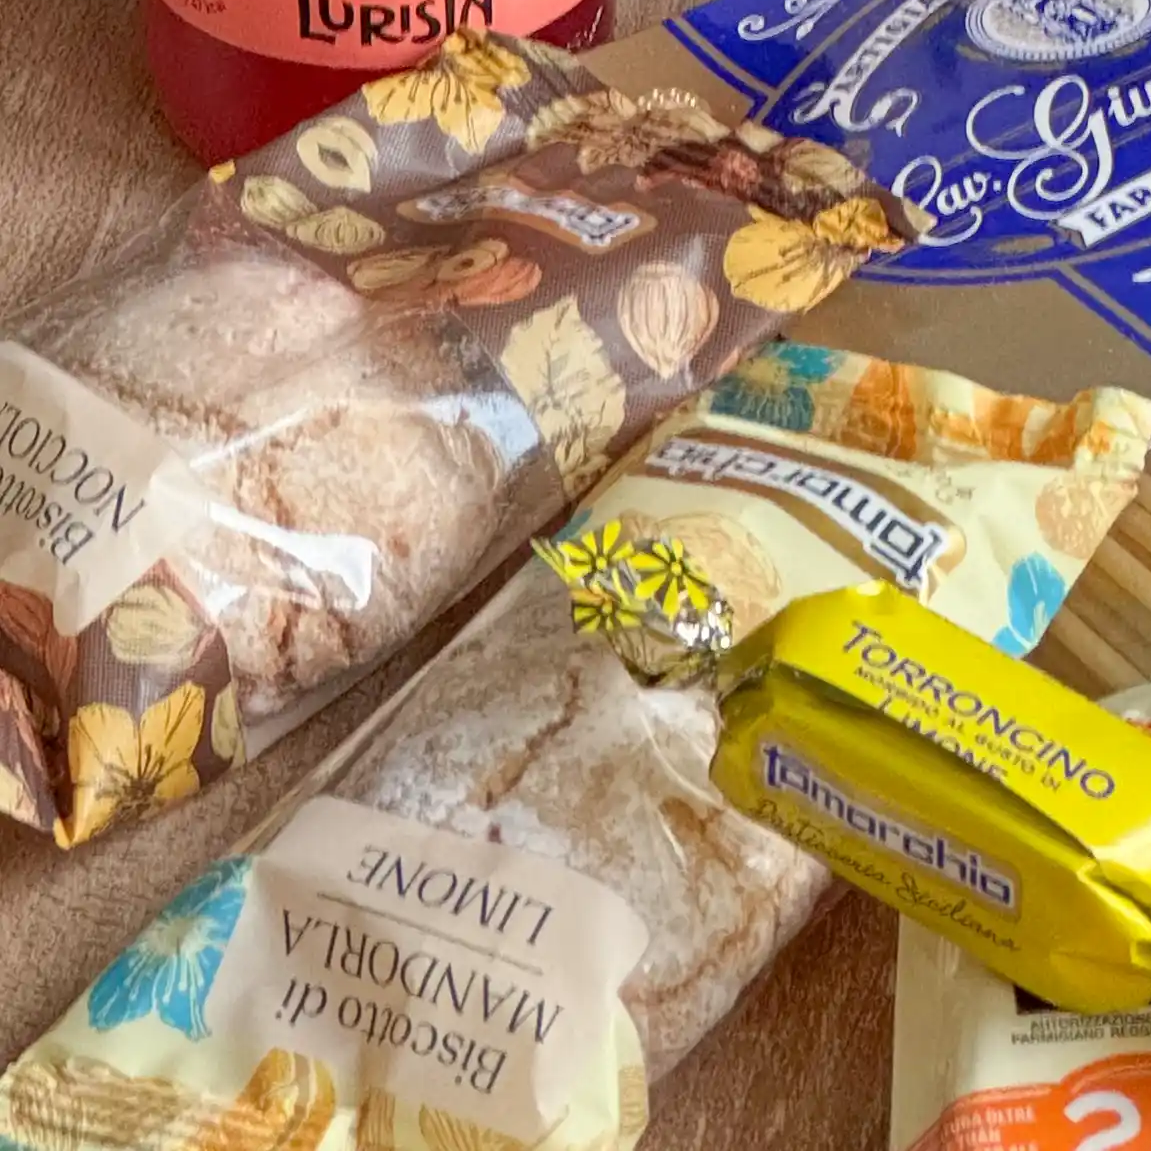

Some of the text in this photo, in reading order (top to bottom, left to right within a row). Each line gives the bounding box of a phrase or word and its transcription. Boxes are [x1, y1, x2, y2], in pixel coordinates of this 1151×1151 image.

[890, 155, 1002, 247] Cav.
[842, 620, 1116, 800] TORRONCINO
[763, 745, 1012, 905] tamarchio
[347, 844, 555, 947] LIMONE
[275, 978, 507, 1095] Biscotto di
[282, 909, 564, 1045] MANDORLA
